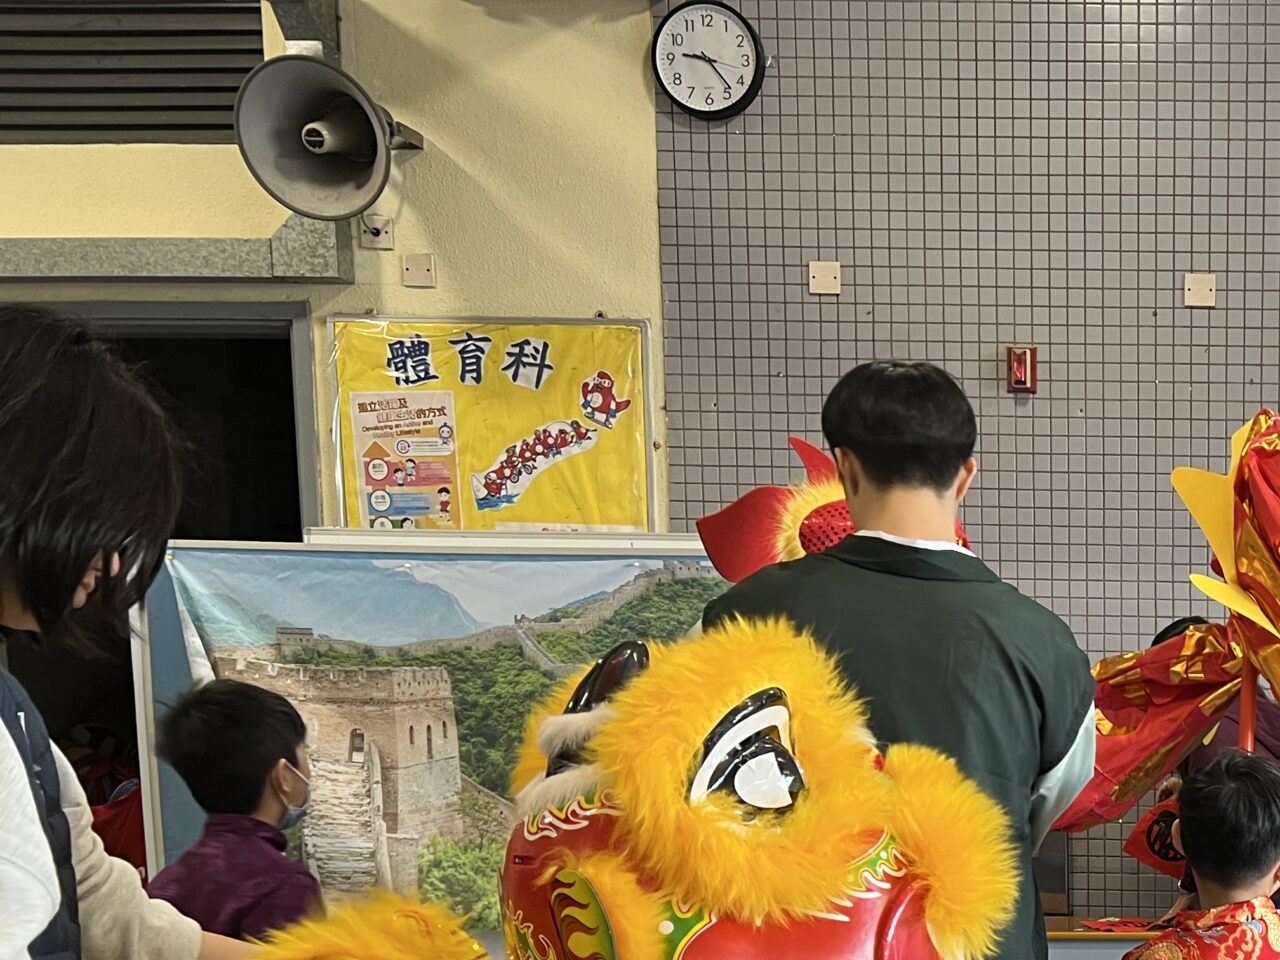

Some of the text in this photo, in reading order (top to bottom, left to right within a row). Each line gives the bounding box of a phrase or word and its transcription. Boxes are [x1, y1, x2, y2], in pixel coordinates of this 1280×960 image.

[684, 19, 695, 32] 11
[700, 14, 714, 28] 12
[671, 33, 684, 46] 10
[736, 34, 745, 48] 2
[666, 52, 676, 66] 9
[741, 54, 750, 67] 3
[673, 72, 682, 86] 8
[736, 75, 745, 86] 4
[687, 86, 696, 99] 7
[705, 92, 714, 106] 6
[722, 87, 732, 100] 5
[386, 332, 554, 390] 體育科
[362, 424, 394, 432] Developing
